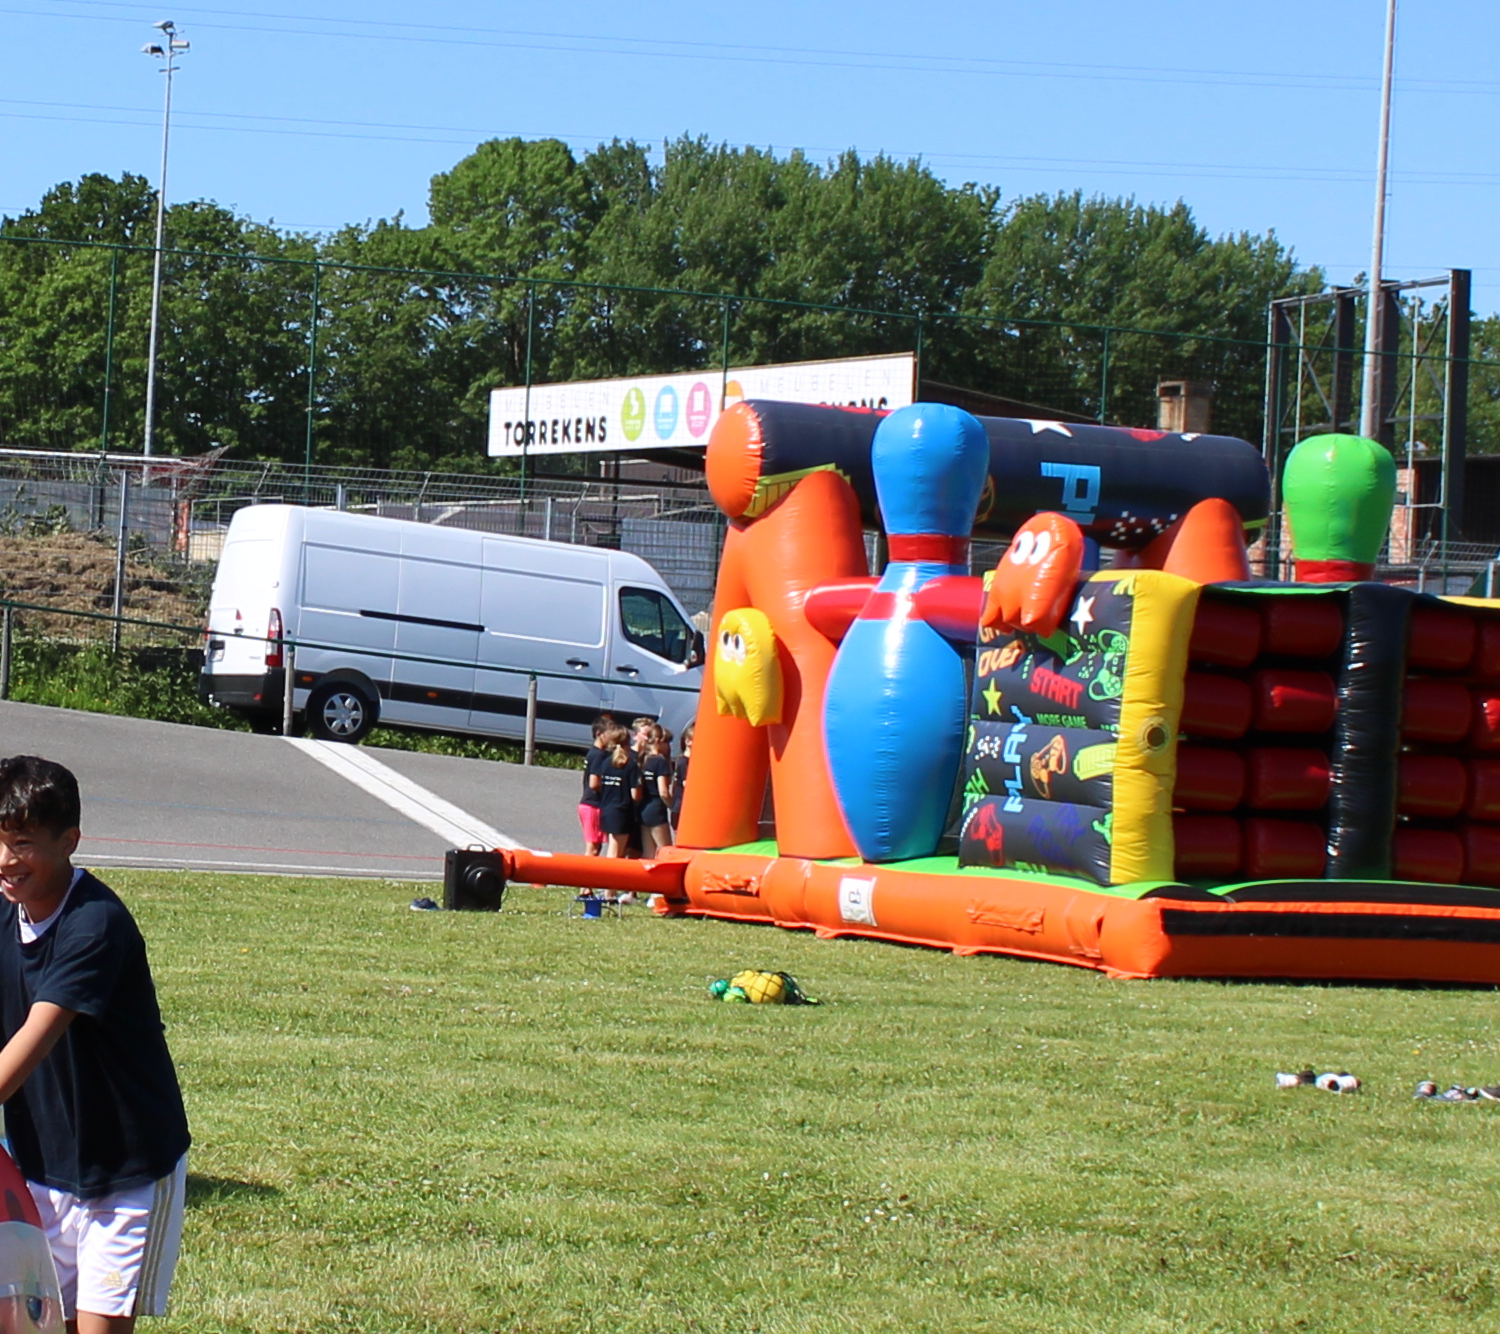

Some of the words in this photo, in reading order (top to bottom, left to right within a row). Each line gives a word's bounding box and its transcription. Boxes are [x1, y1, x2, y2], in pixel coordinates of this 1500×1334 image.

[503, 416, 607, 447] TORREKENS
[1029, 666, 1084, 709] START
[1003, 704, 1033, 813] PLAY
